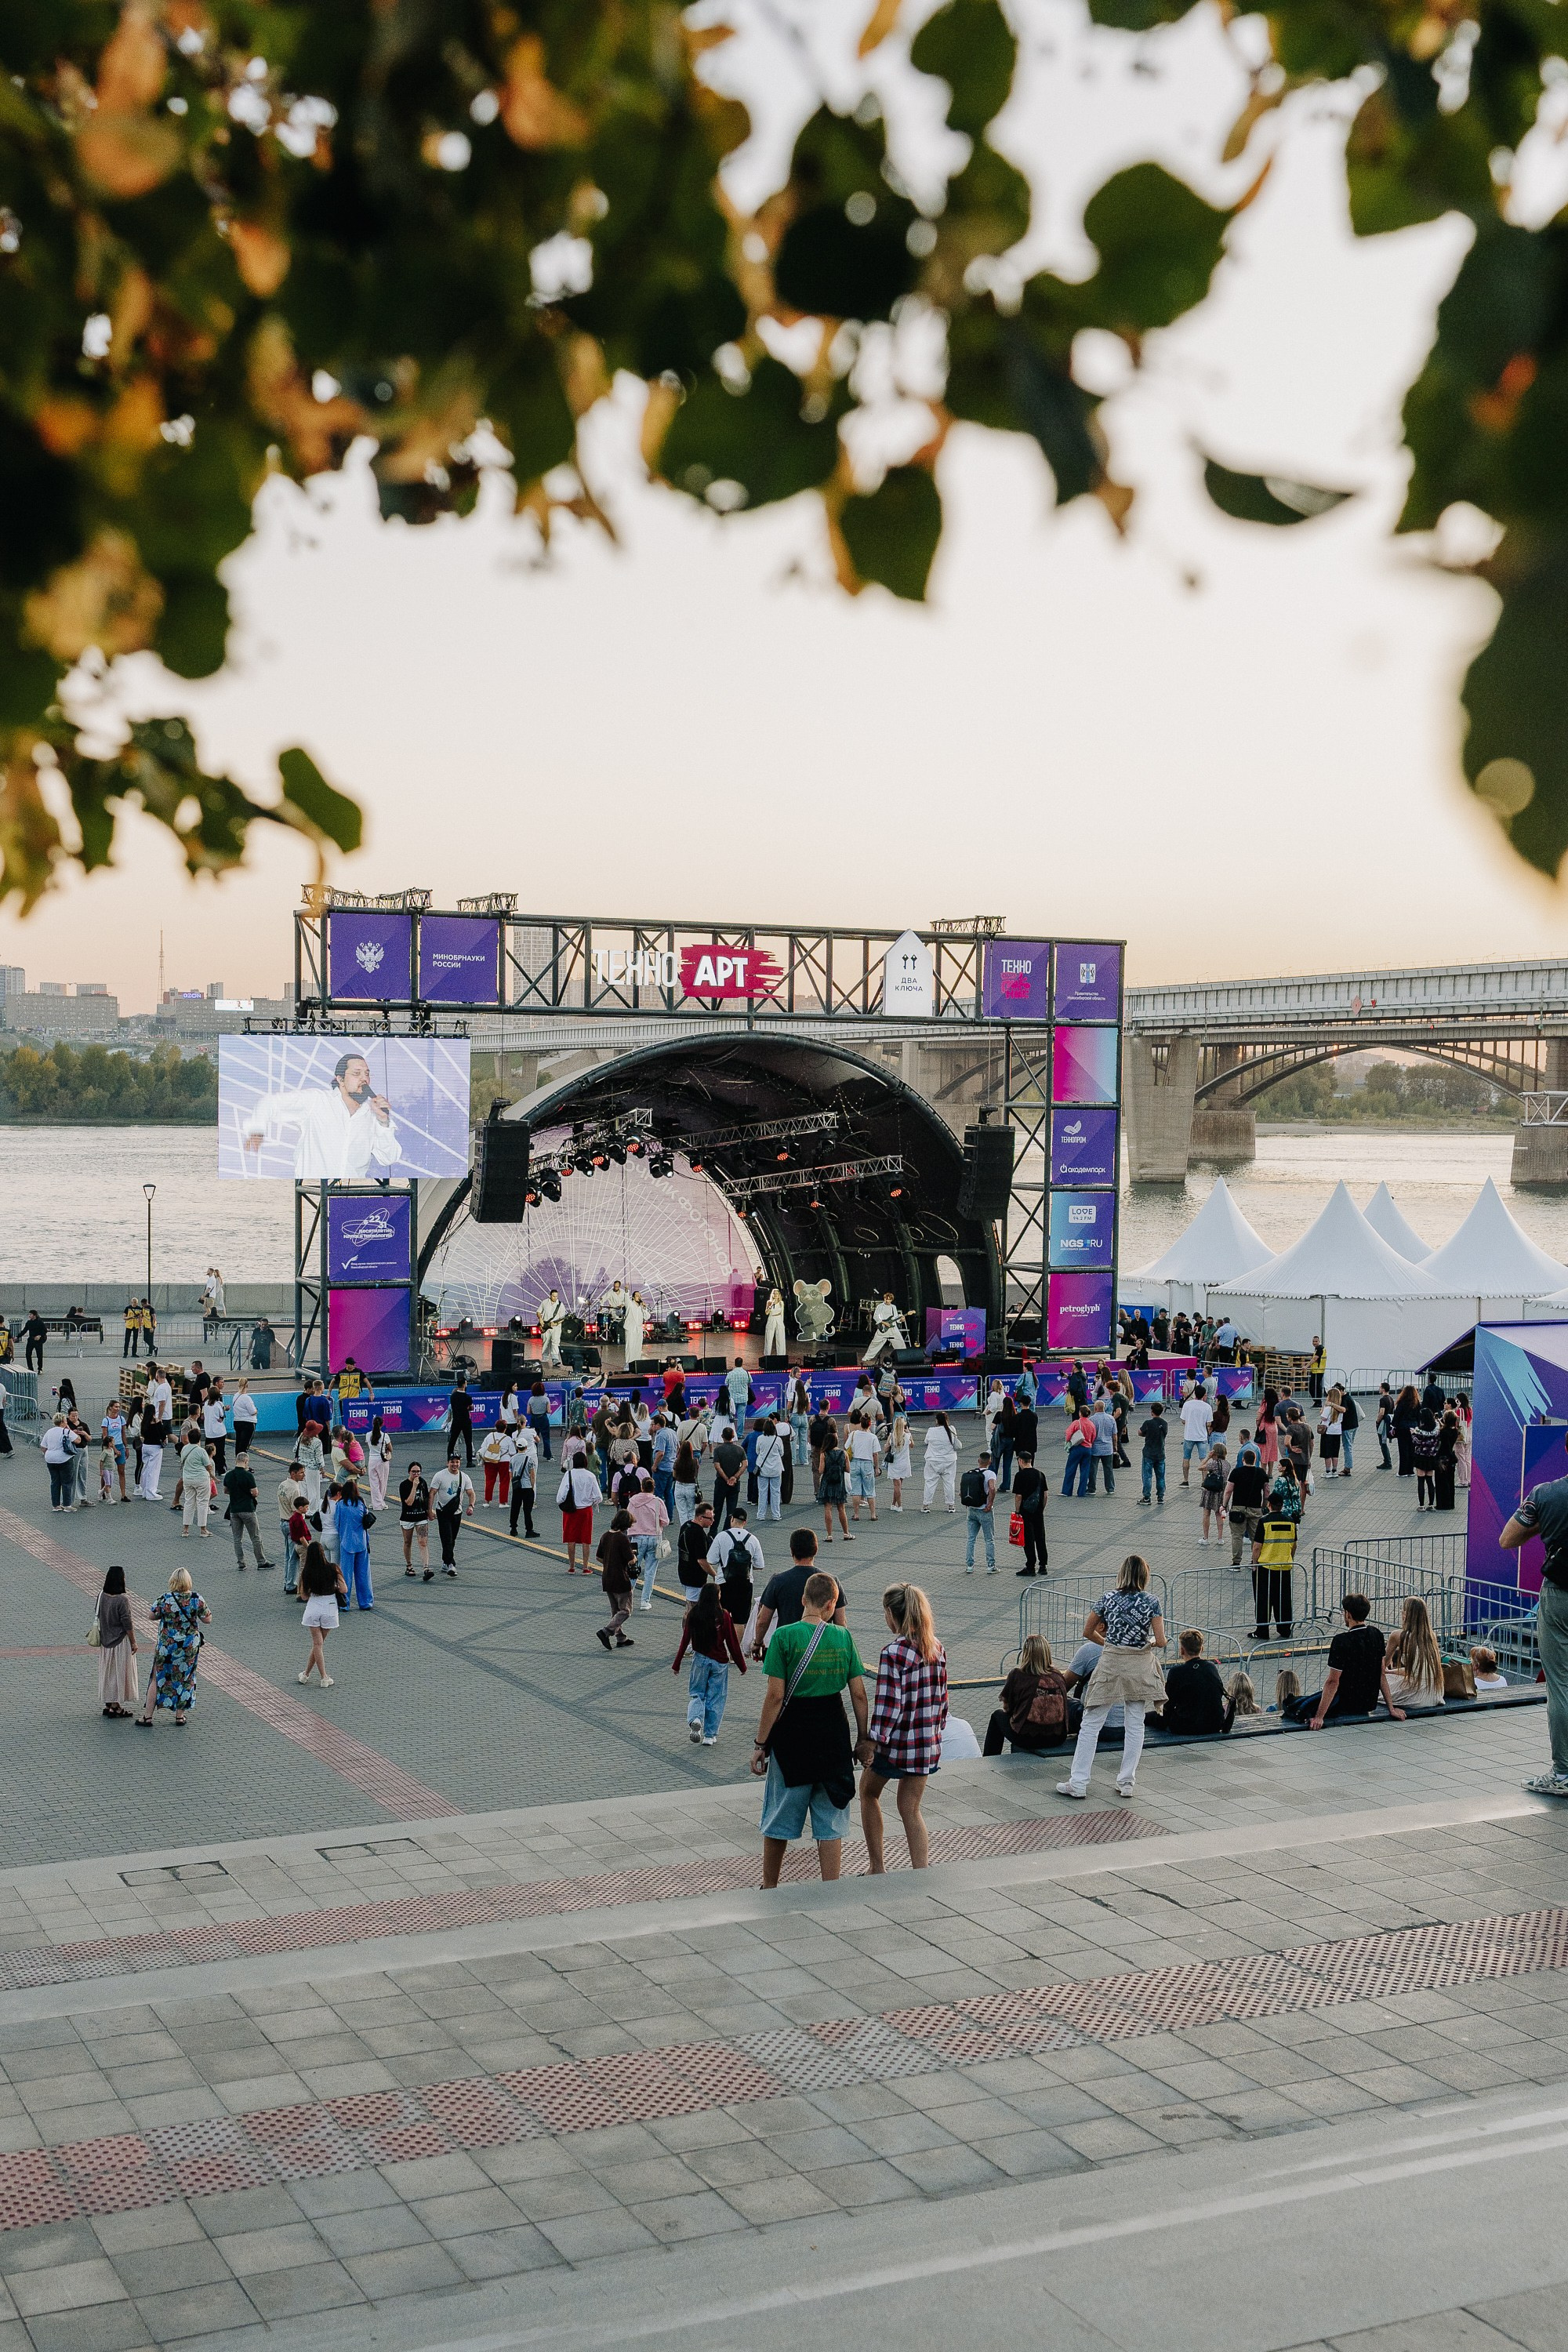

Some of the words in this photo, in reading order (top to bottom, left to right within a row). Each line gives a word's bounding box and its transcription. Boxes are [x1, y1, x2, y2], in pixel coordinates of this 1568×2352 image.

[432, 953, 485, 962] МИНОБРНАУКИ
[590, 949, 678, 988] ТЕХНО
[692, 955, 749, 988] АРТ
[1001, 959, 1032, 975] ТЕХНО
[1059, 1304, 1100, 1315] petroglyph
[348, 1409, 368, 1418] ТЕХНО
[383, 1405, 402, 1414] ТЕХНО
